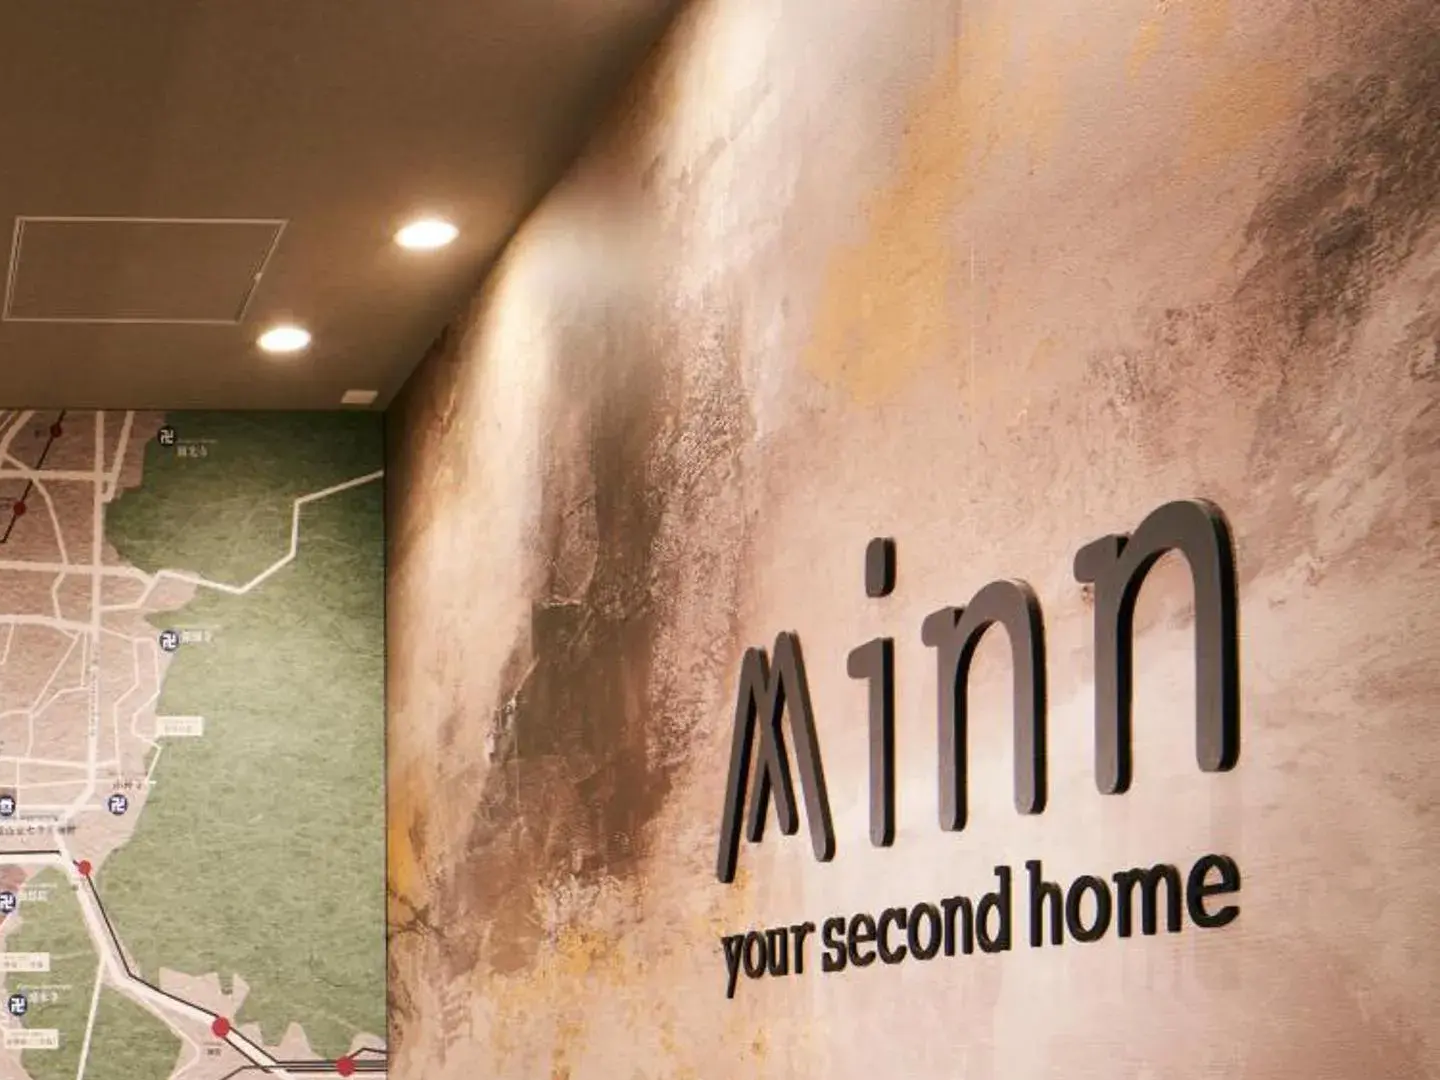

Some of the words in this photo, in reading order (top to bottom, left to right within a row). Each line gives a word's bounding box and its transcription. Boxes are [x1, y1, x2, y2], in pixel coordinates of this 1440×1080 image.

[716, 498, 1241, 884] Minn
[721, 922, 816, 999] your
[821, 865, 1011, 973] second
[1026, 853, 1241, 947] home
